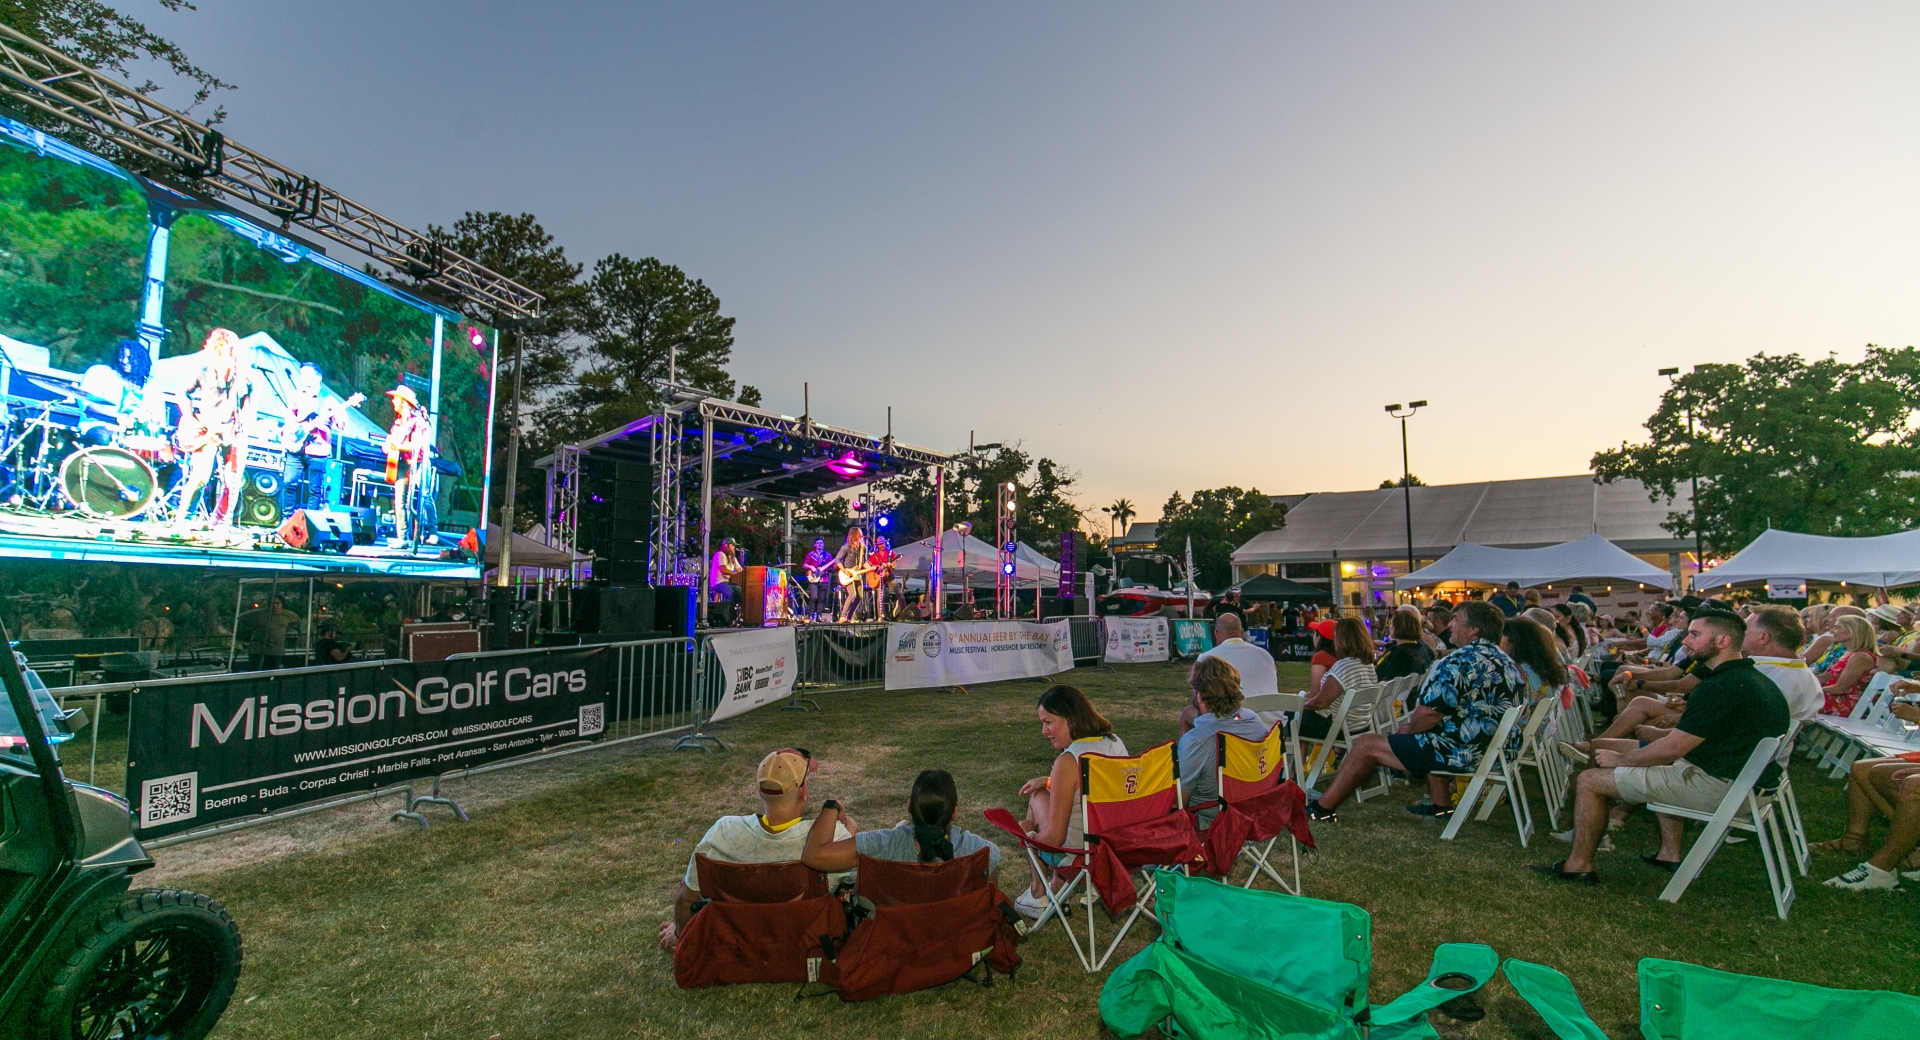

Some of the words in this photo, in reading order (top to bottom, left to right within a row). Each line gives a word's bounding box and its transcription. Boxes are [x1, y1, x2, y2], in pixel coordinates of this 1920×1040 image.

[958, 632, 991, 644] ANNUAL
[992, 632, 1008, 642] BEER
[1009, 631, 1017, 641] BY
[1019, 631, 1031, 640] THE
[1032, 632, 1050, 641] BAY
[965, 646, 987, 654] FESTIVAL
[991, 643, 1019, 653] HORSESHOE
[1027, 643, 1047, 651] RESORT
[742, 666, 754, 681] IBC
[734, 680, 752, 695] BANK
[190, 686, 406, 748] Mission
[415, 670, 498, 714] Golf
[504, 667, 587, 701] Cars
[294, 729, 448, 763] WWW.MISSIONGOLFCARS.COM
[452, 714, 533, 736] @MISSIONGOLFCARS
[204, 793, 248, 811] Boerne
[259, 784, 289, 799] Buda
[299, 774, 337, 791] Corpus
[338, 766, 369, 782] Christi
[378, 757, 409, 773] Marble
[410, 756, 431, 768] Falls
[438, 752, 455, 763] Port
[455, 748, 487, 760] Aransas
[493, 743, 507, 751] San
[508, 737, 534, 749] Antonio
[540, 732, 554, 743] Tyler
[558, 728, 576, 738] Waco
